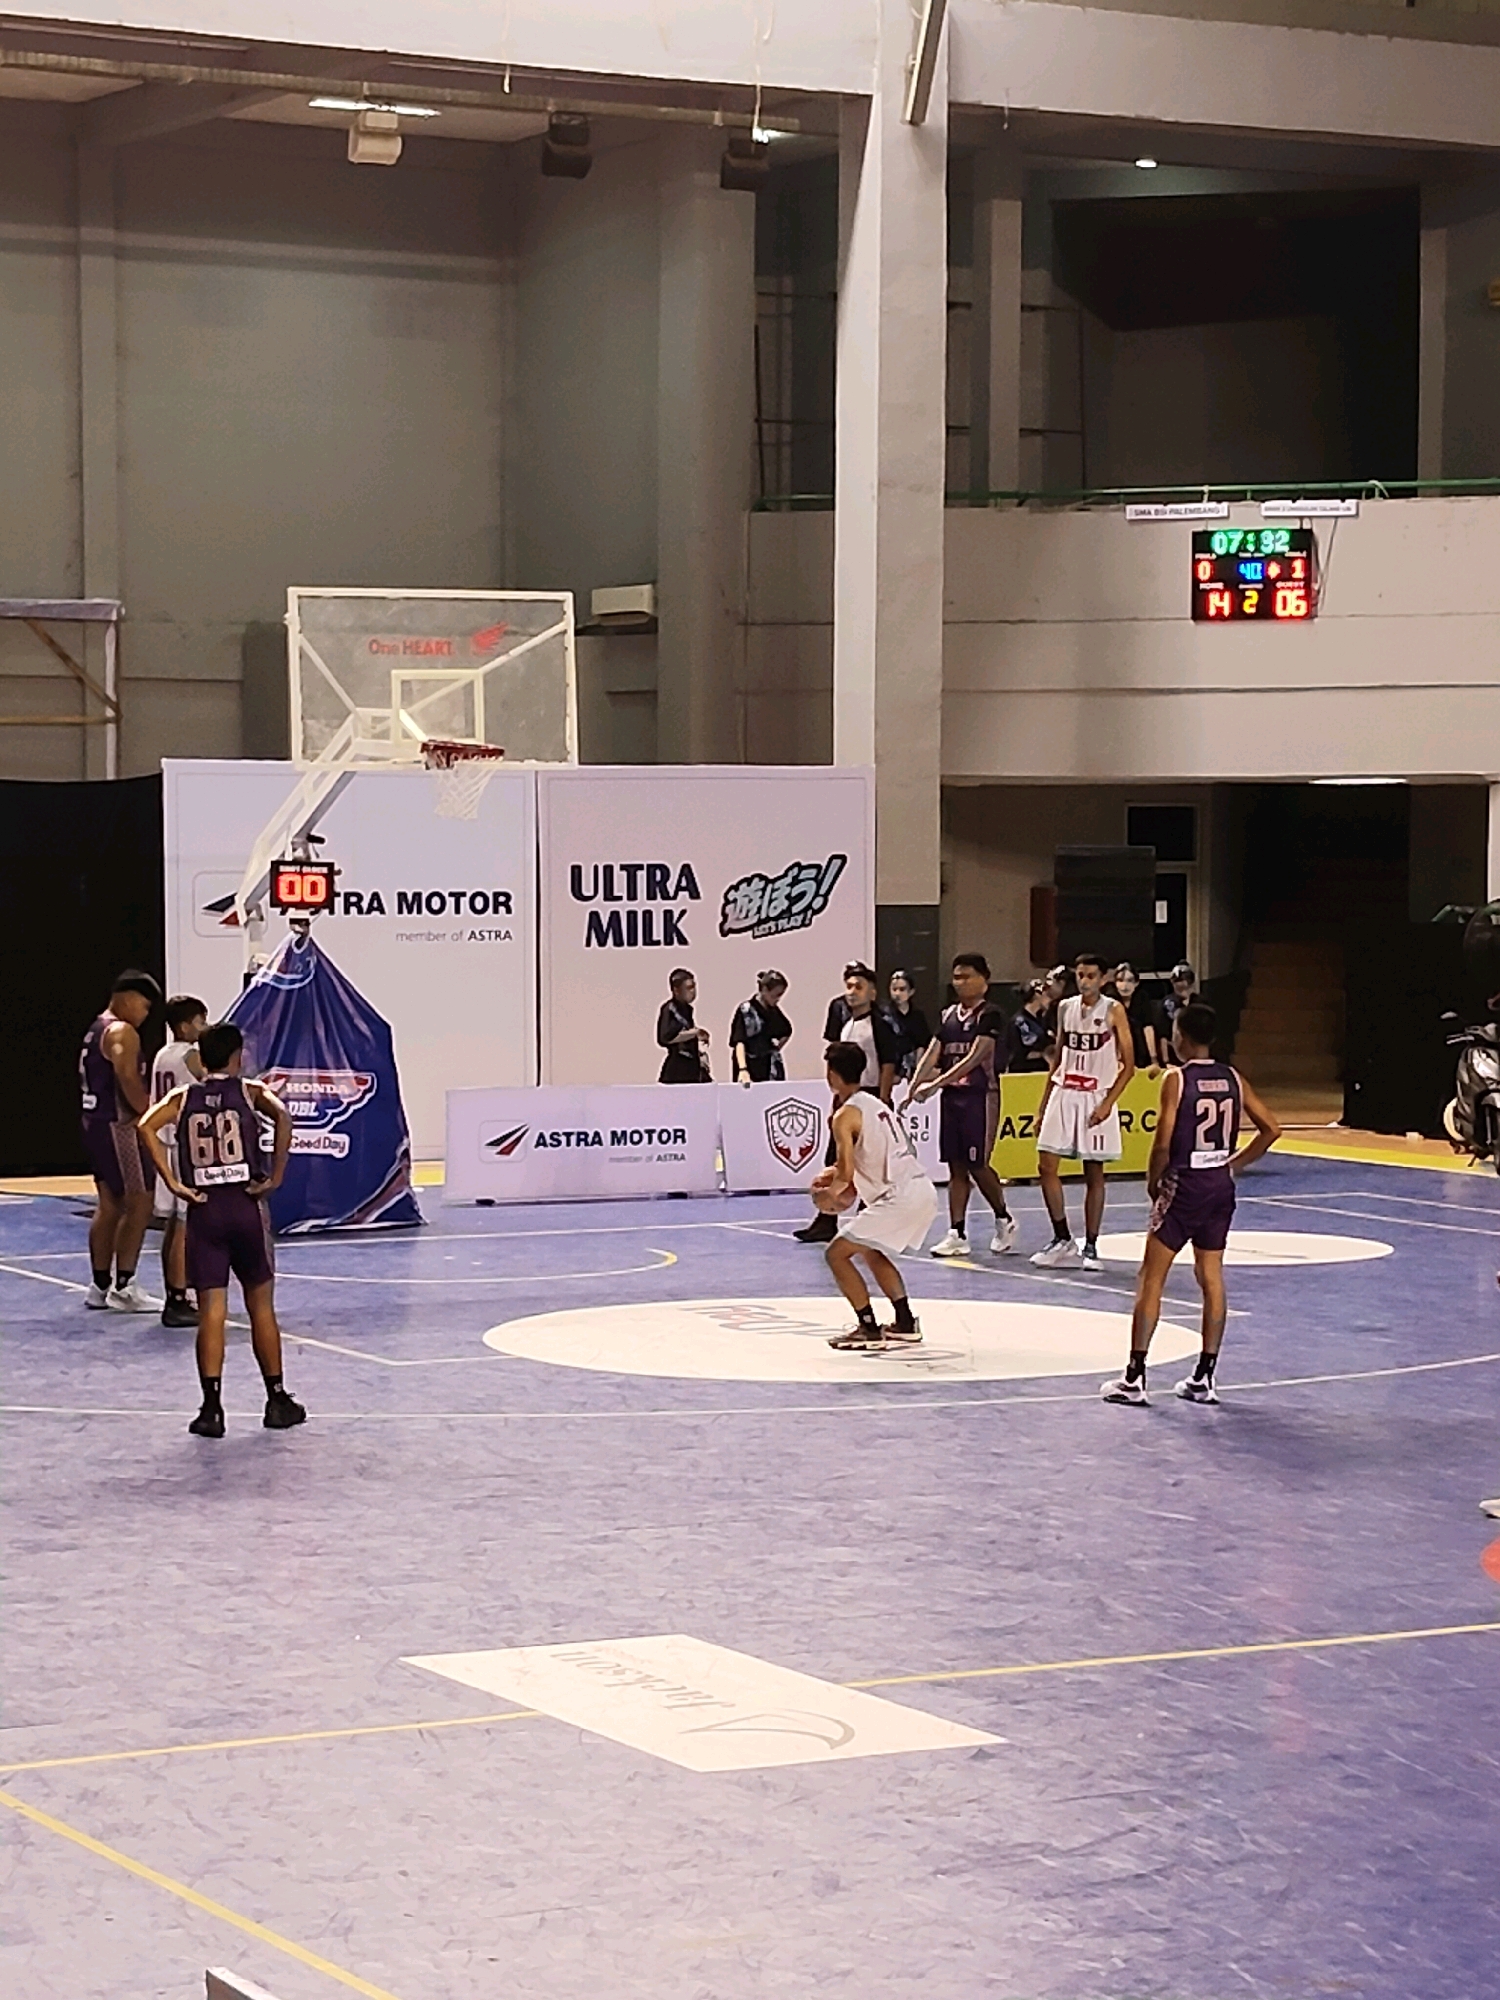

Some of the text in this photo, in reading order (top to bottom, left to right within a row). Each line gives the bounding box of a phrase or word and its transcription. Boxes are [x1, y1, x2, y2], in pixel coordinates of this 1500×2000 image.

[1197, 560, 1211, 581] 0
[1291, 559, 1305, 578] 1
[1208, 590, 1232, 617] 14
[1243, 589, 1259, 614] 2
[1275, 589, 1308, 617] 06
[368, 639, 452, 656] One HEART
[278, 873, 327, 903] 00
[571, 863, 702, 902] ULTRA
[397, 891, 513, 916] MOTOR
[396, 929, 513, 942] member of ASTRA
[585, 908, 690, 948] MILK
[1068, 1033, 1099, 1050] BSI
[285, 1082, 349, 1094] HONDA
[1195, 1098, 1234, 1151] 21
[188, 1109, 244, 1167] 68
[533, 1128, 687, 1149] ASTRA MOTOR
[1092, 1134, 1105, 1151] 11
[655, 1153, 687, 1162] ASTRA
